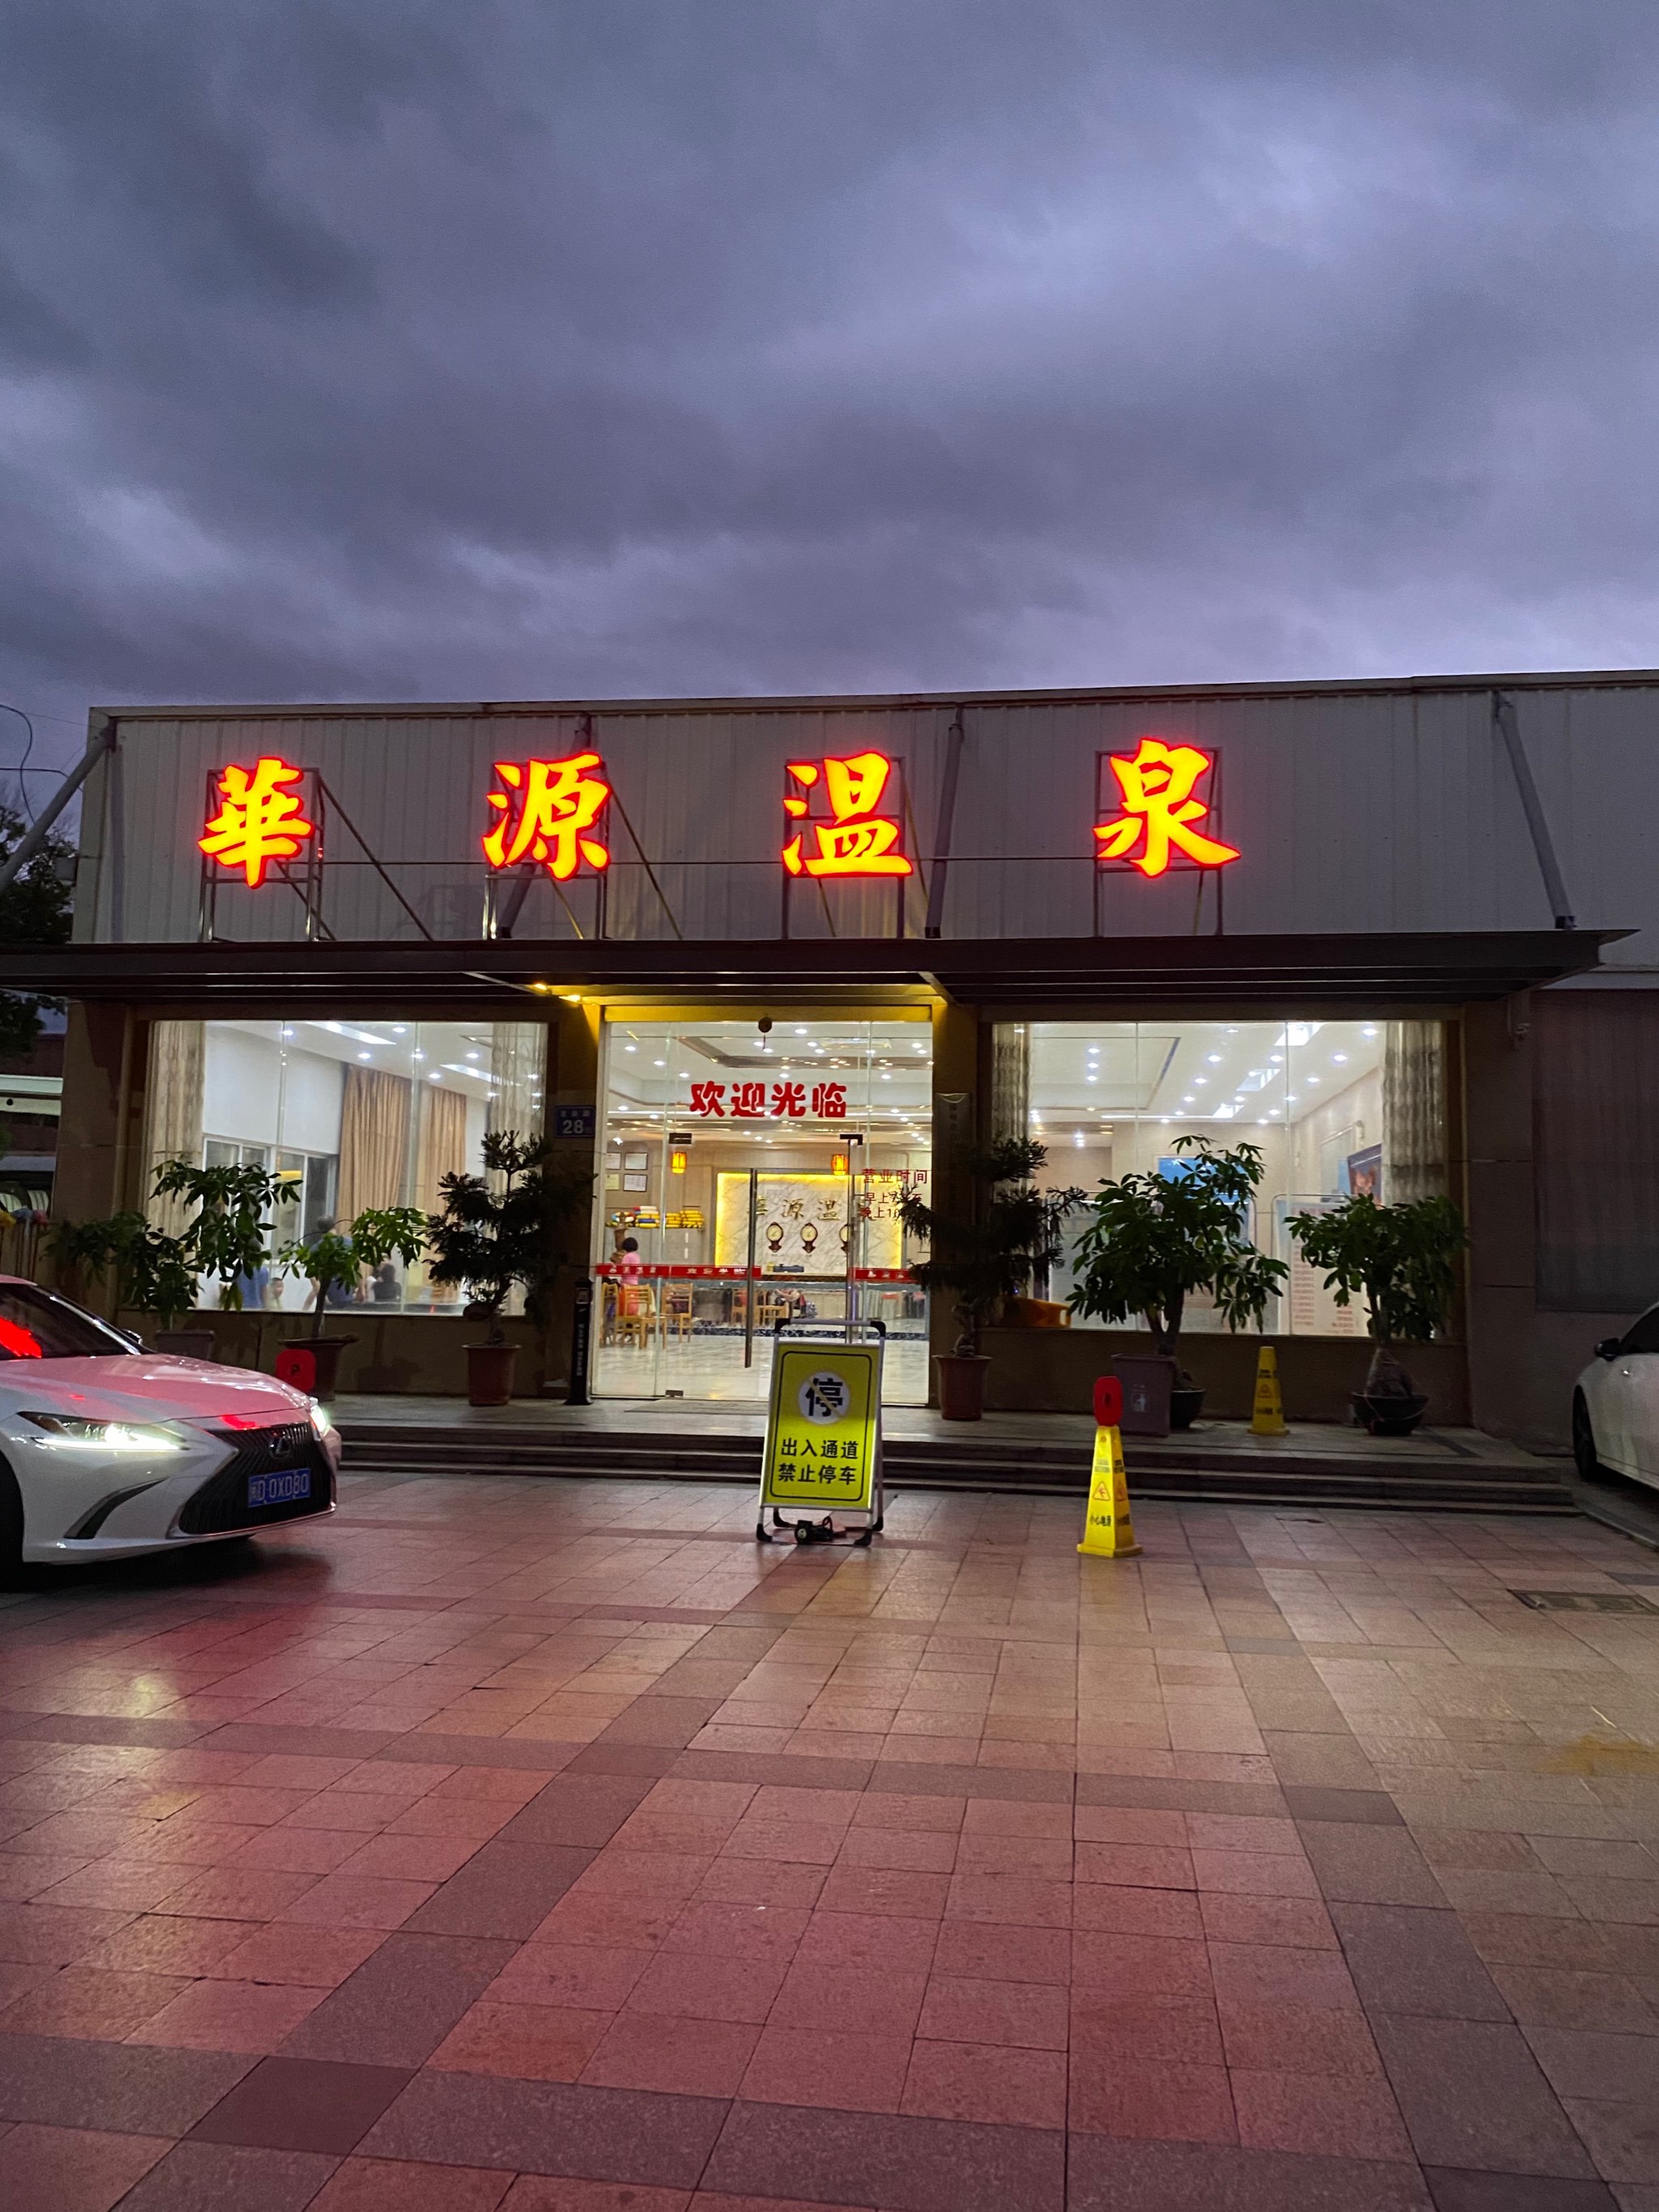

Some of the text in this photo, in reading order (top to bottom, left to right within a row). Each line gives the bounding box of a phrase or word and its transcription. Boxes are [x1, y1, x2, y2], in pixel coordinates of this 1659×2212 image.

[689, 1080, 847, 1117] 欢迎光临
[862, 1168, 928, 1184] 营业时间
[805, 1377, 844, 1417] 停
[781, 1437, 859, 1459] 出入通道
[778, 1463, 857, 1486] 禁止停车
